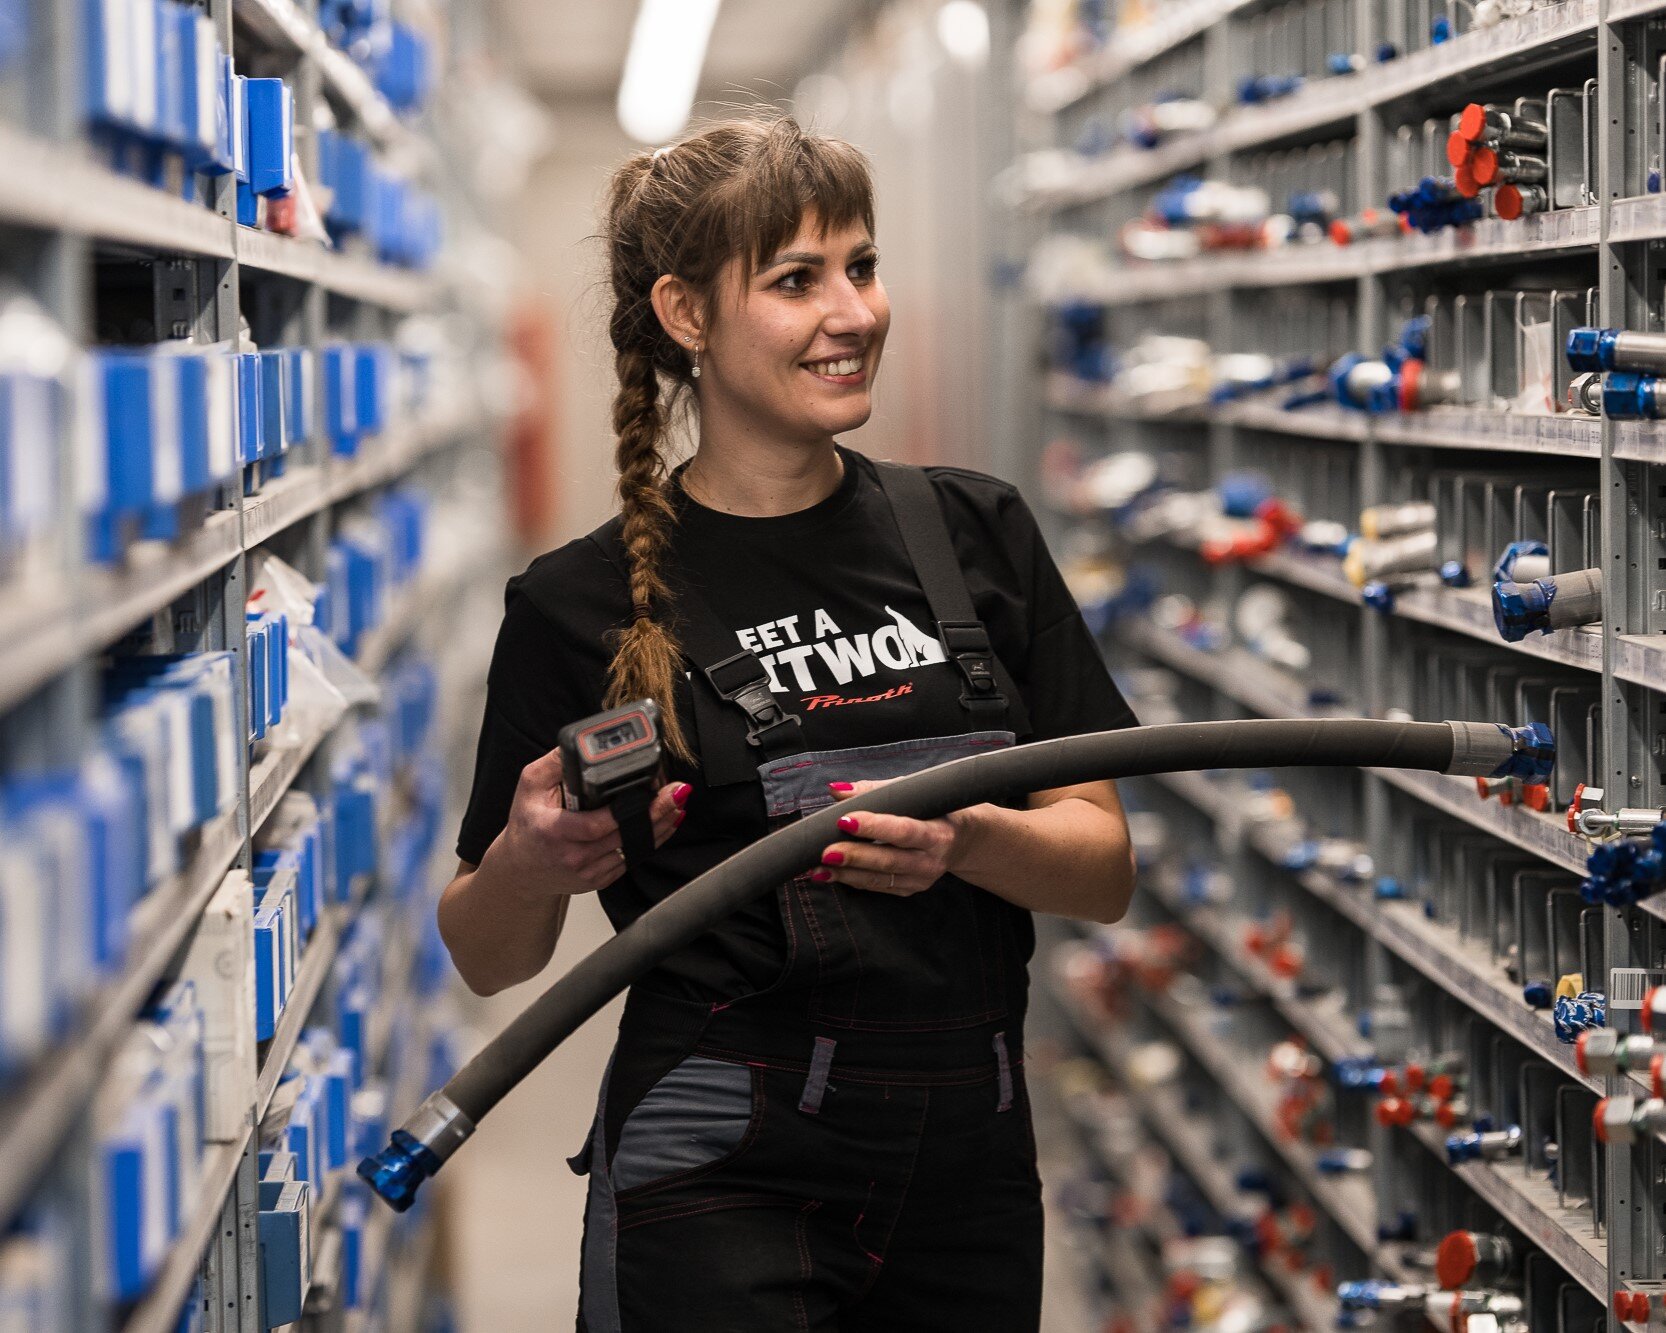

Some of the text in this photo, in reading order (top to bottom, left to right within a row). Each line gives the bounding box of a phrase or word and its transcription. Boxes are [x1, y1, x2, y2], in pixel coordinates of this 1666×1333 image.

[735, 608, 842, 653] EET A
[800, 685, 913, 711] Prinoth
